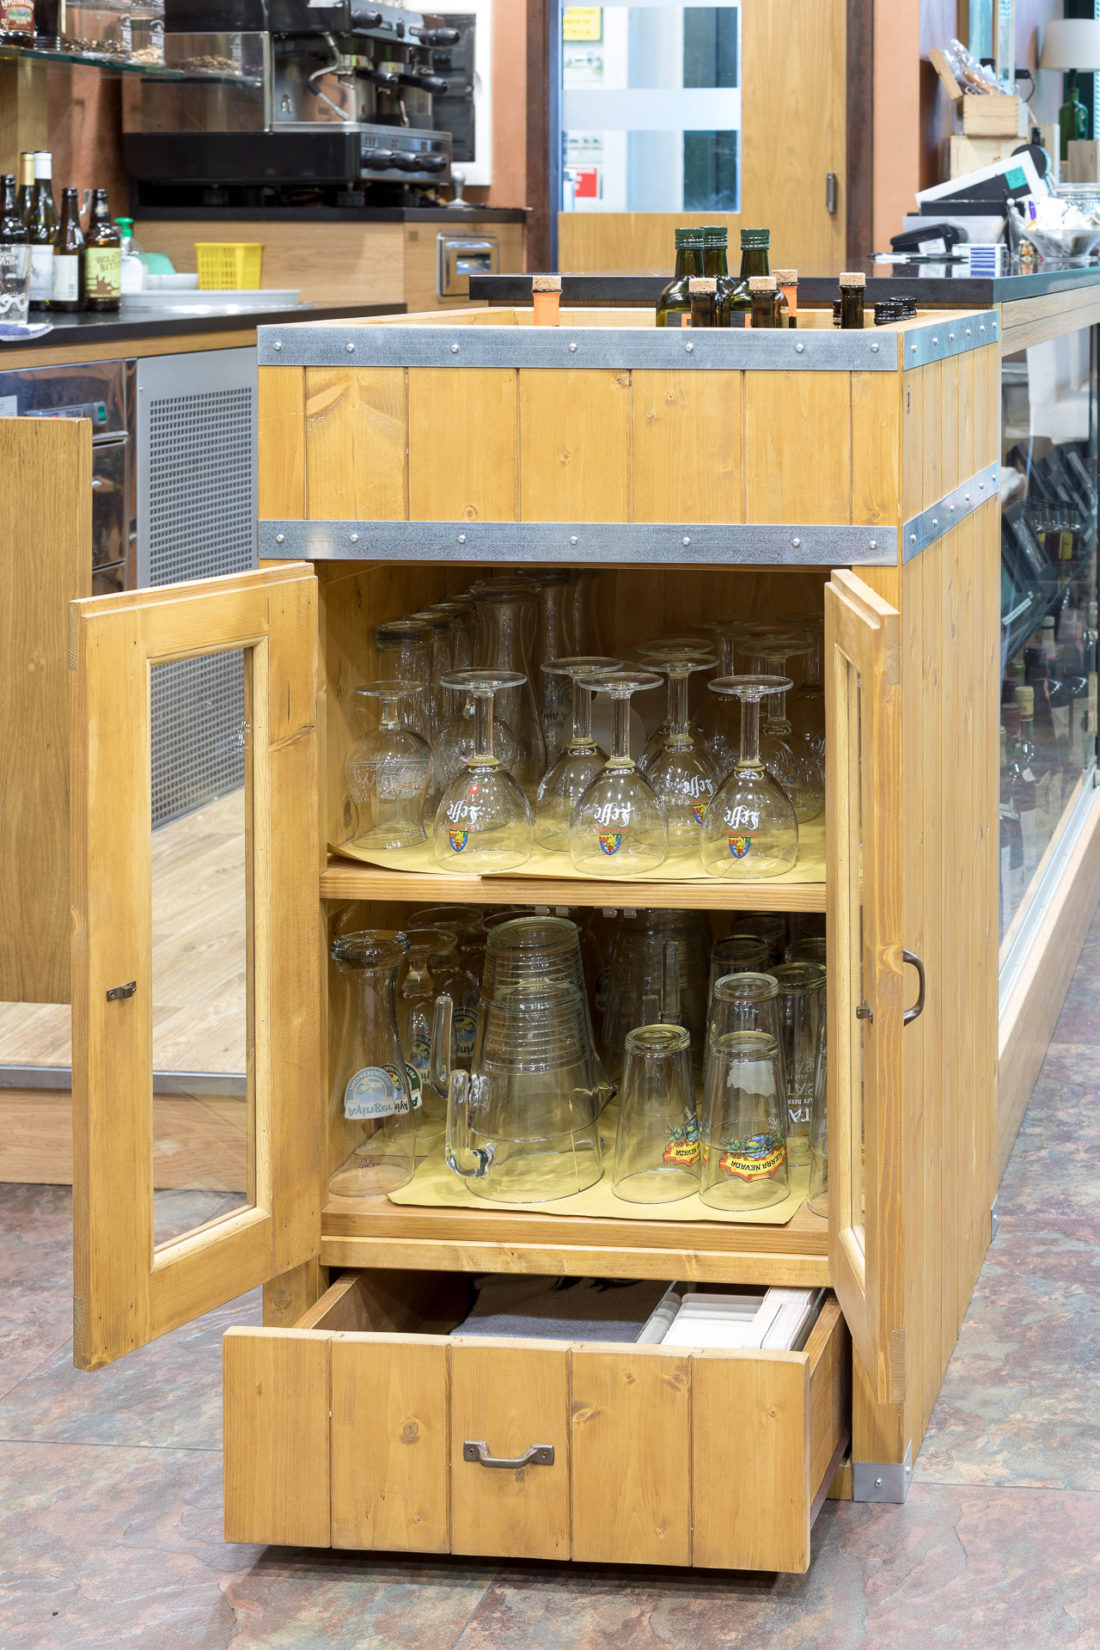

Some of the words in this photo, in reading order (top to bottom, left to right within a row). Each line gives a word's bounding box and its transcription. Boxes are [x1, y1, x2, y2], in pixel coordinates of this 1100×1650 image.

[682, 774, 713, 799] Leffe
[447, 799, 481, 825] Leffe
[594, 802, 632, 828] Leffe
[723, 805, 761, 831] Leffe
[731, 1161, 761, 1172] NEVADA
